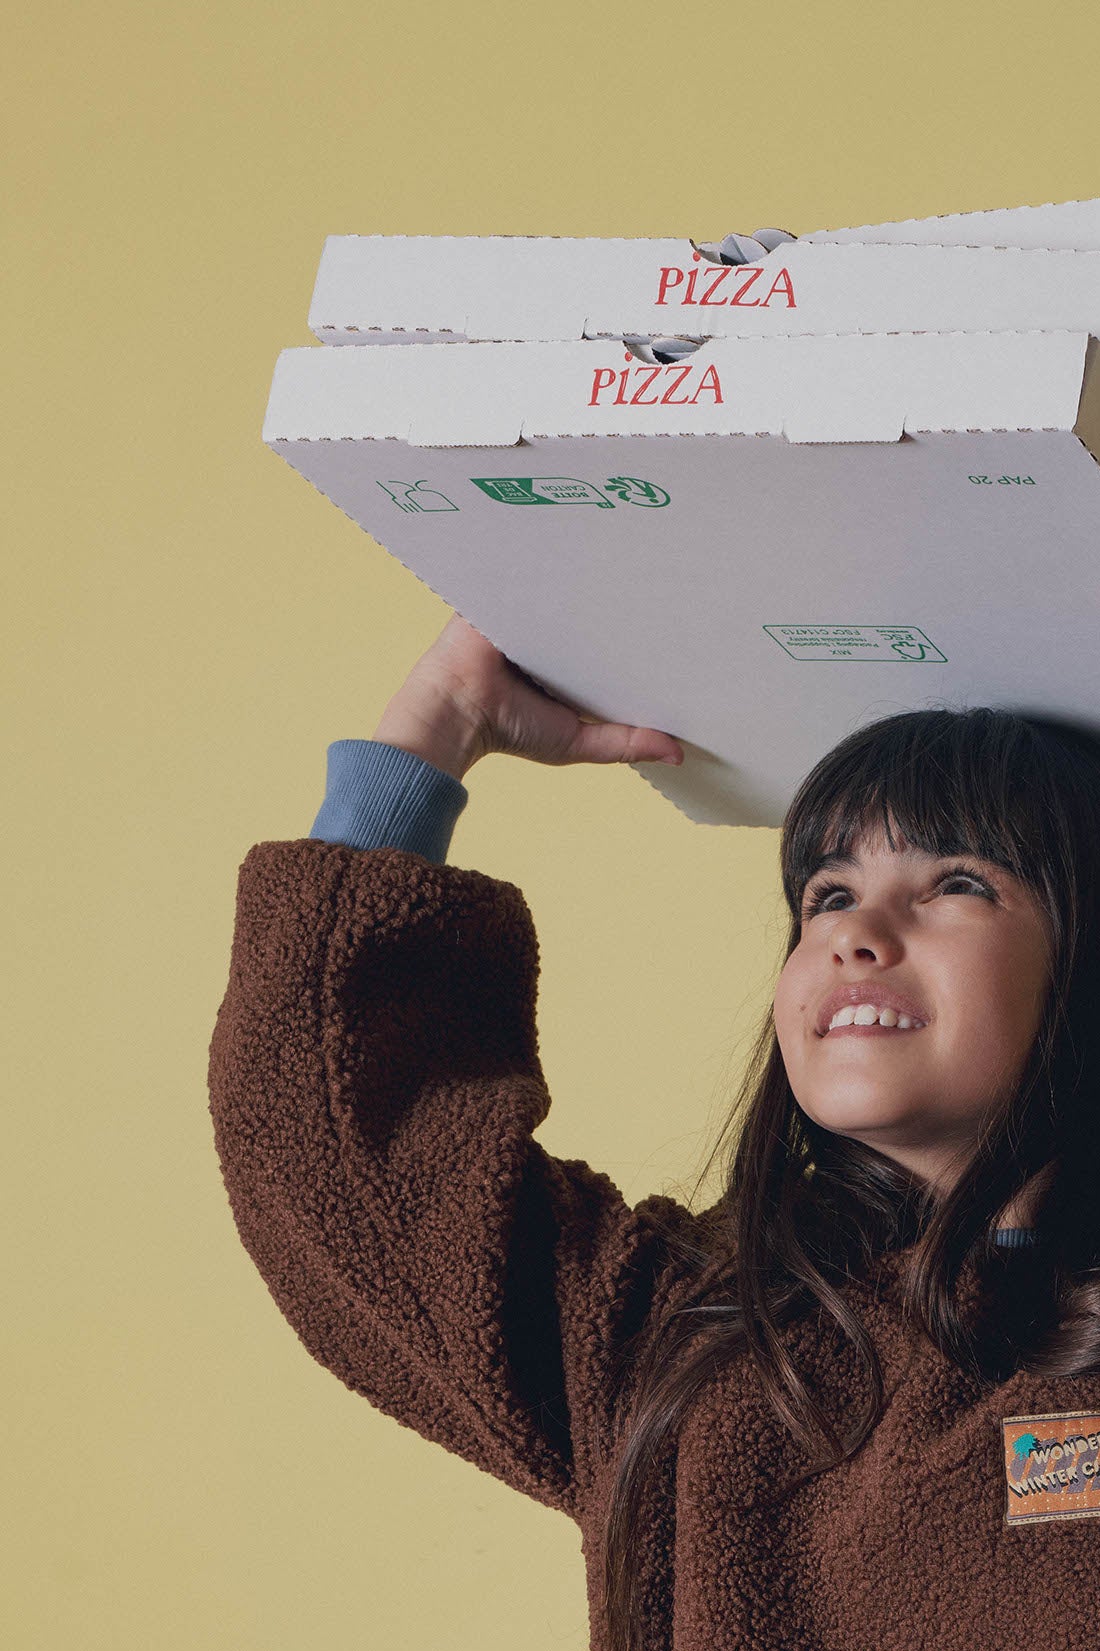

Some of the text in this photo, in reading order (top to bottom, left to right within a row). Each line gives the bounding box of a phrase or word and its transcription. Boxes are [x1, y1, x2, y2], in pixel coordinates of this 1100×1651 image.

[968, 475, 1036, 485] PAP 20
[1009, 1466, 1079, 1499] WINTER
